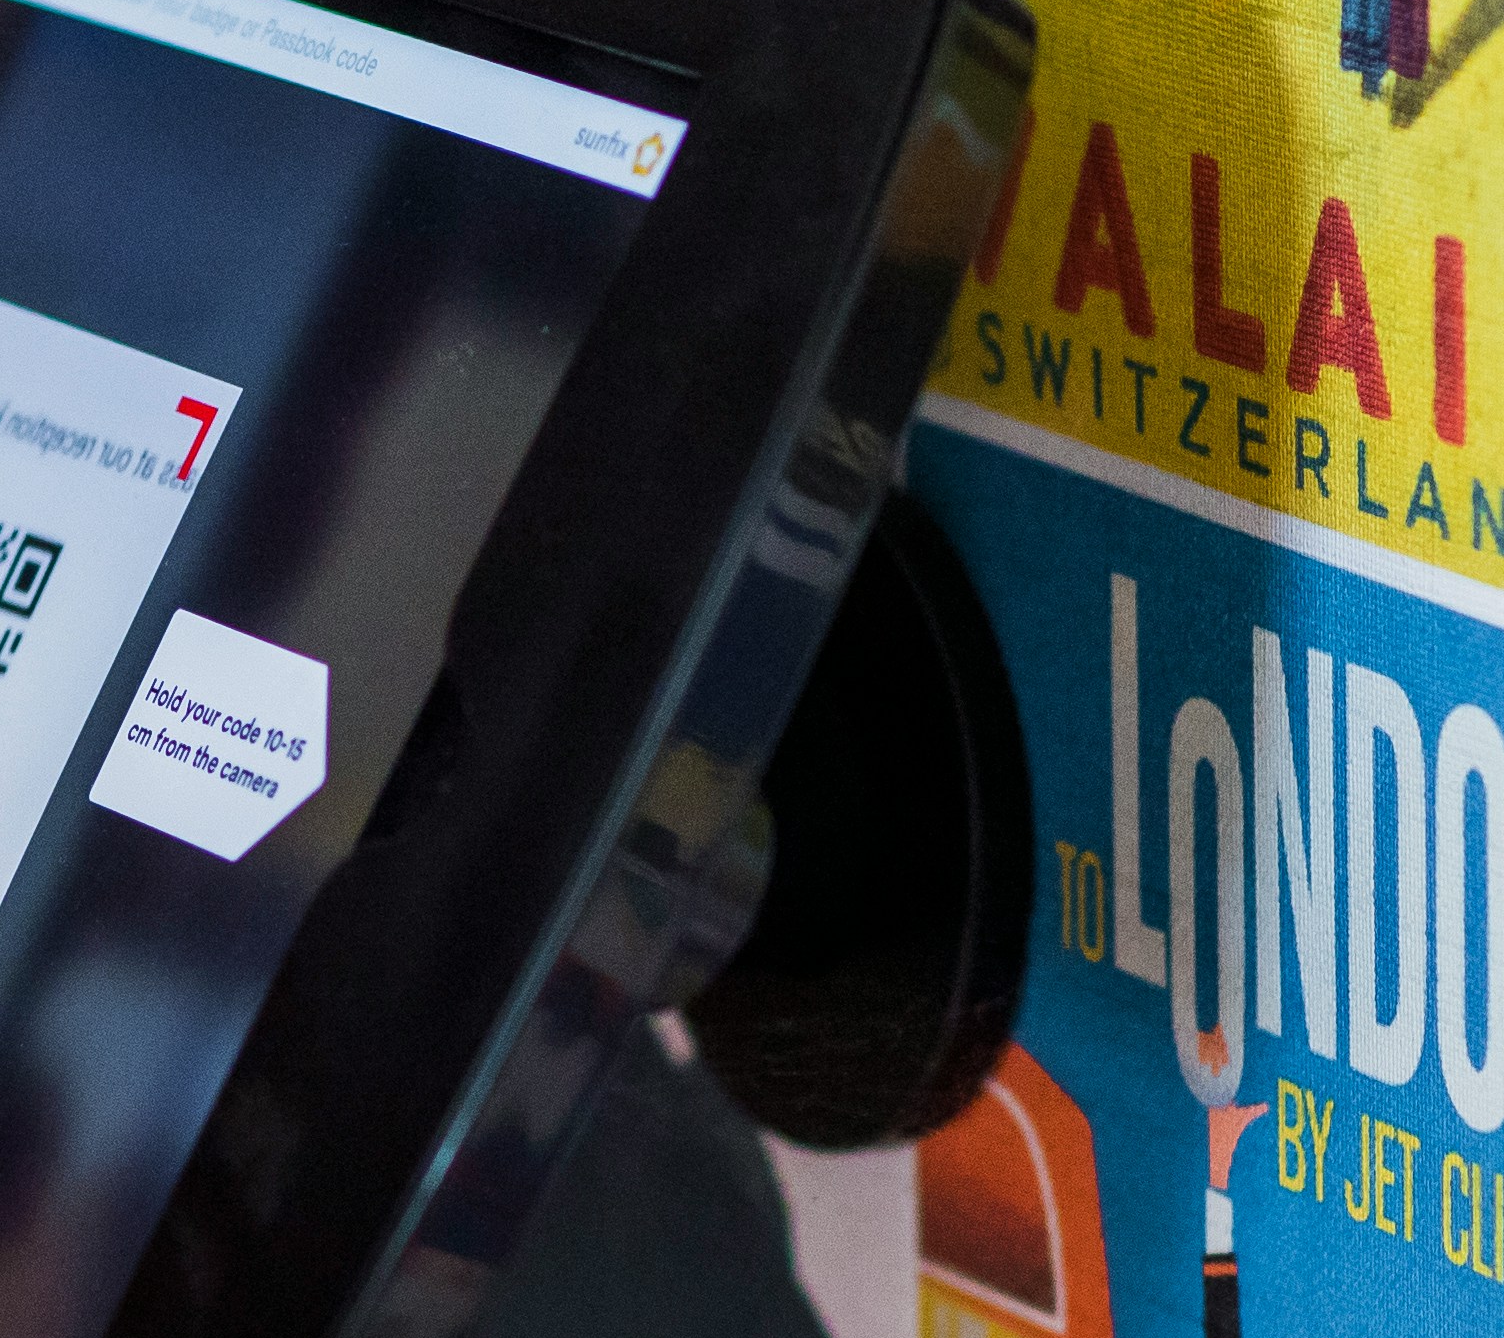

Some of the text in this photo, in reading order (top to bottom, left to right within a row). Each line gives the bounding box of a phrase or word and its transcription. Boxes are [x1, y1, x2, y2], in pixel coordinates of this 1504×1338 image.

[190, 1, 240, 37] badge
[262, 17, 336, 63] Passbook
[335, 48, 379, 76] code
[145, 678, 307, 761] Hold your code 10-15
[127, 724, 279, 799] cm from the camera
[1055, 840, 1104, 963] TO
[1277, 1079, 1334, 1206] BY
[1345, 1114, 1421, 1242] JET
